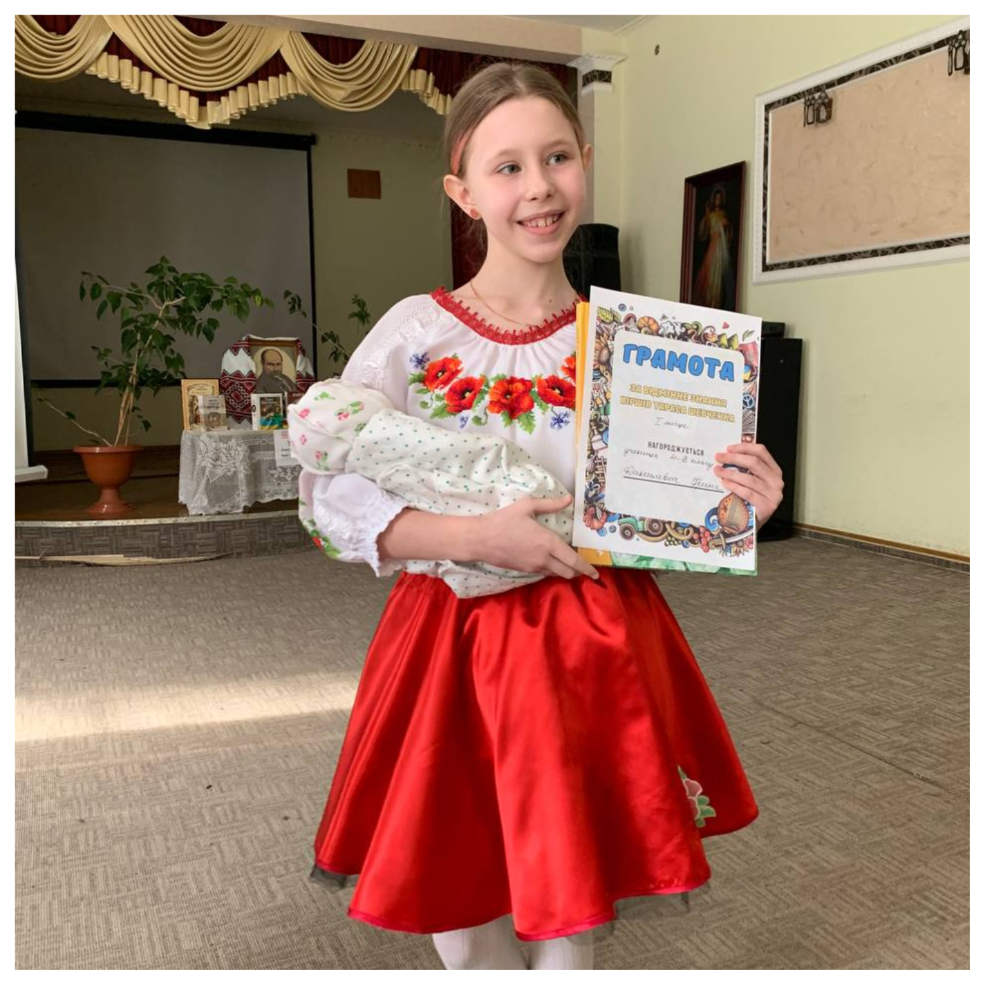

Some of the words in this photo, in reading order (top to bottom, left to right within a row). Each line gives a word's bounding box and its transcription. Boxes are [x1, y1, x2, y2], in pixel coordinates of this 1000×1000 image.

[622, 343, 735, 382] ГРАМОТА
[629, 383, 642, 394] ЗА
[643, 385, 689, 402] ВІДМІННЕ
[690, 394, 728, 408] ЗНАННЯ
[620, 396, 652, 409] ВІРШІВ
[653, 400, 687, 415] ТАРАСА
[688, 407, 736, 423] ШЕВЧЕНКА
[647, 441, 704, 456] НАГОРОДЖУЄТЬСЯ
